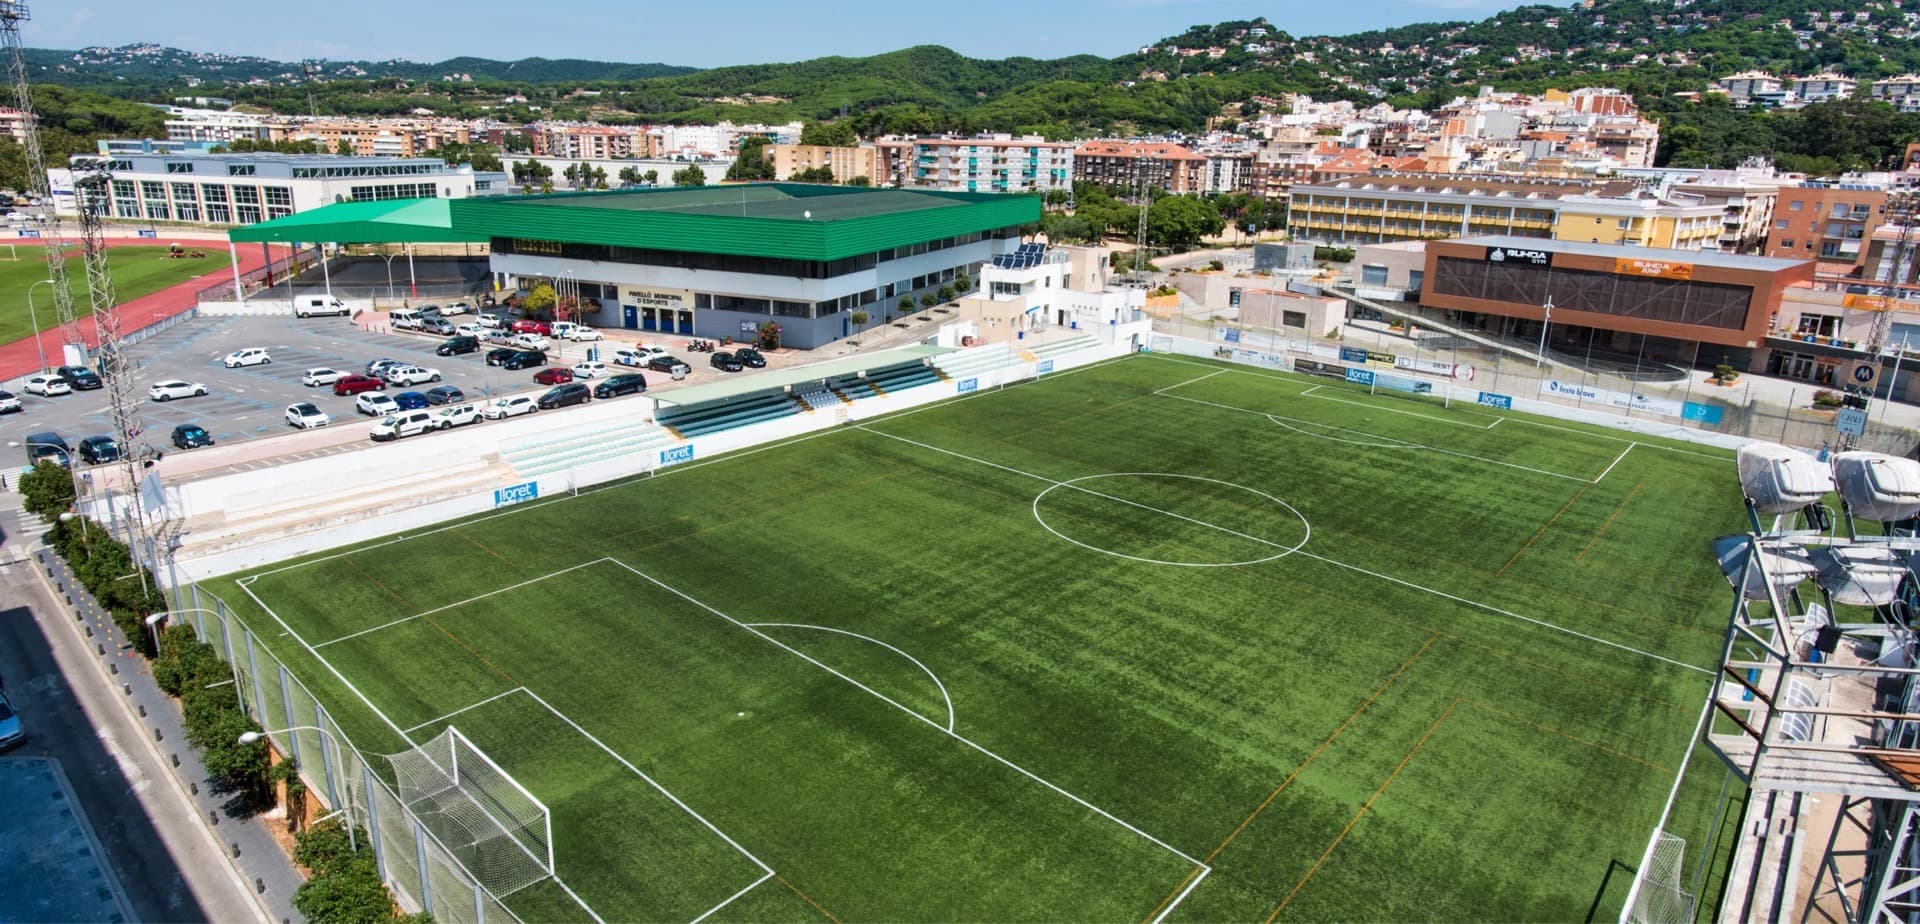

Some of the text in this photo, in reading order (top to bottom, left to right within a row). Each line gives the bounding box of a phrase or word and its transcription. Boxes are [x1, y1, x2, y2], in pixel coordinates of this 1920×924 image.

[654, 293, 682, 301] MUNICIPAL
[1433, 362, 1451, 370] DENT
[1349, 368, 1370, 380] lloret
[663, 445, 690, 461] lloret
[499, 482, 532, 502] lloret
